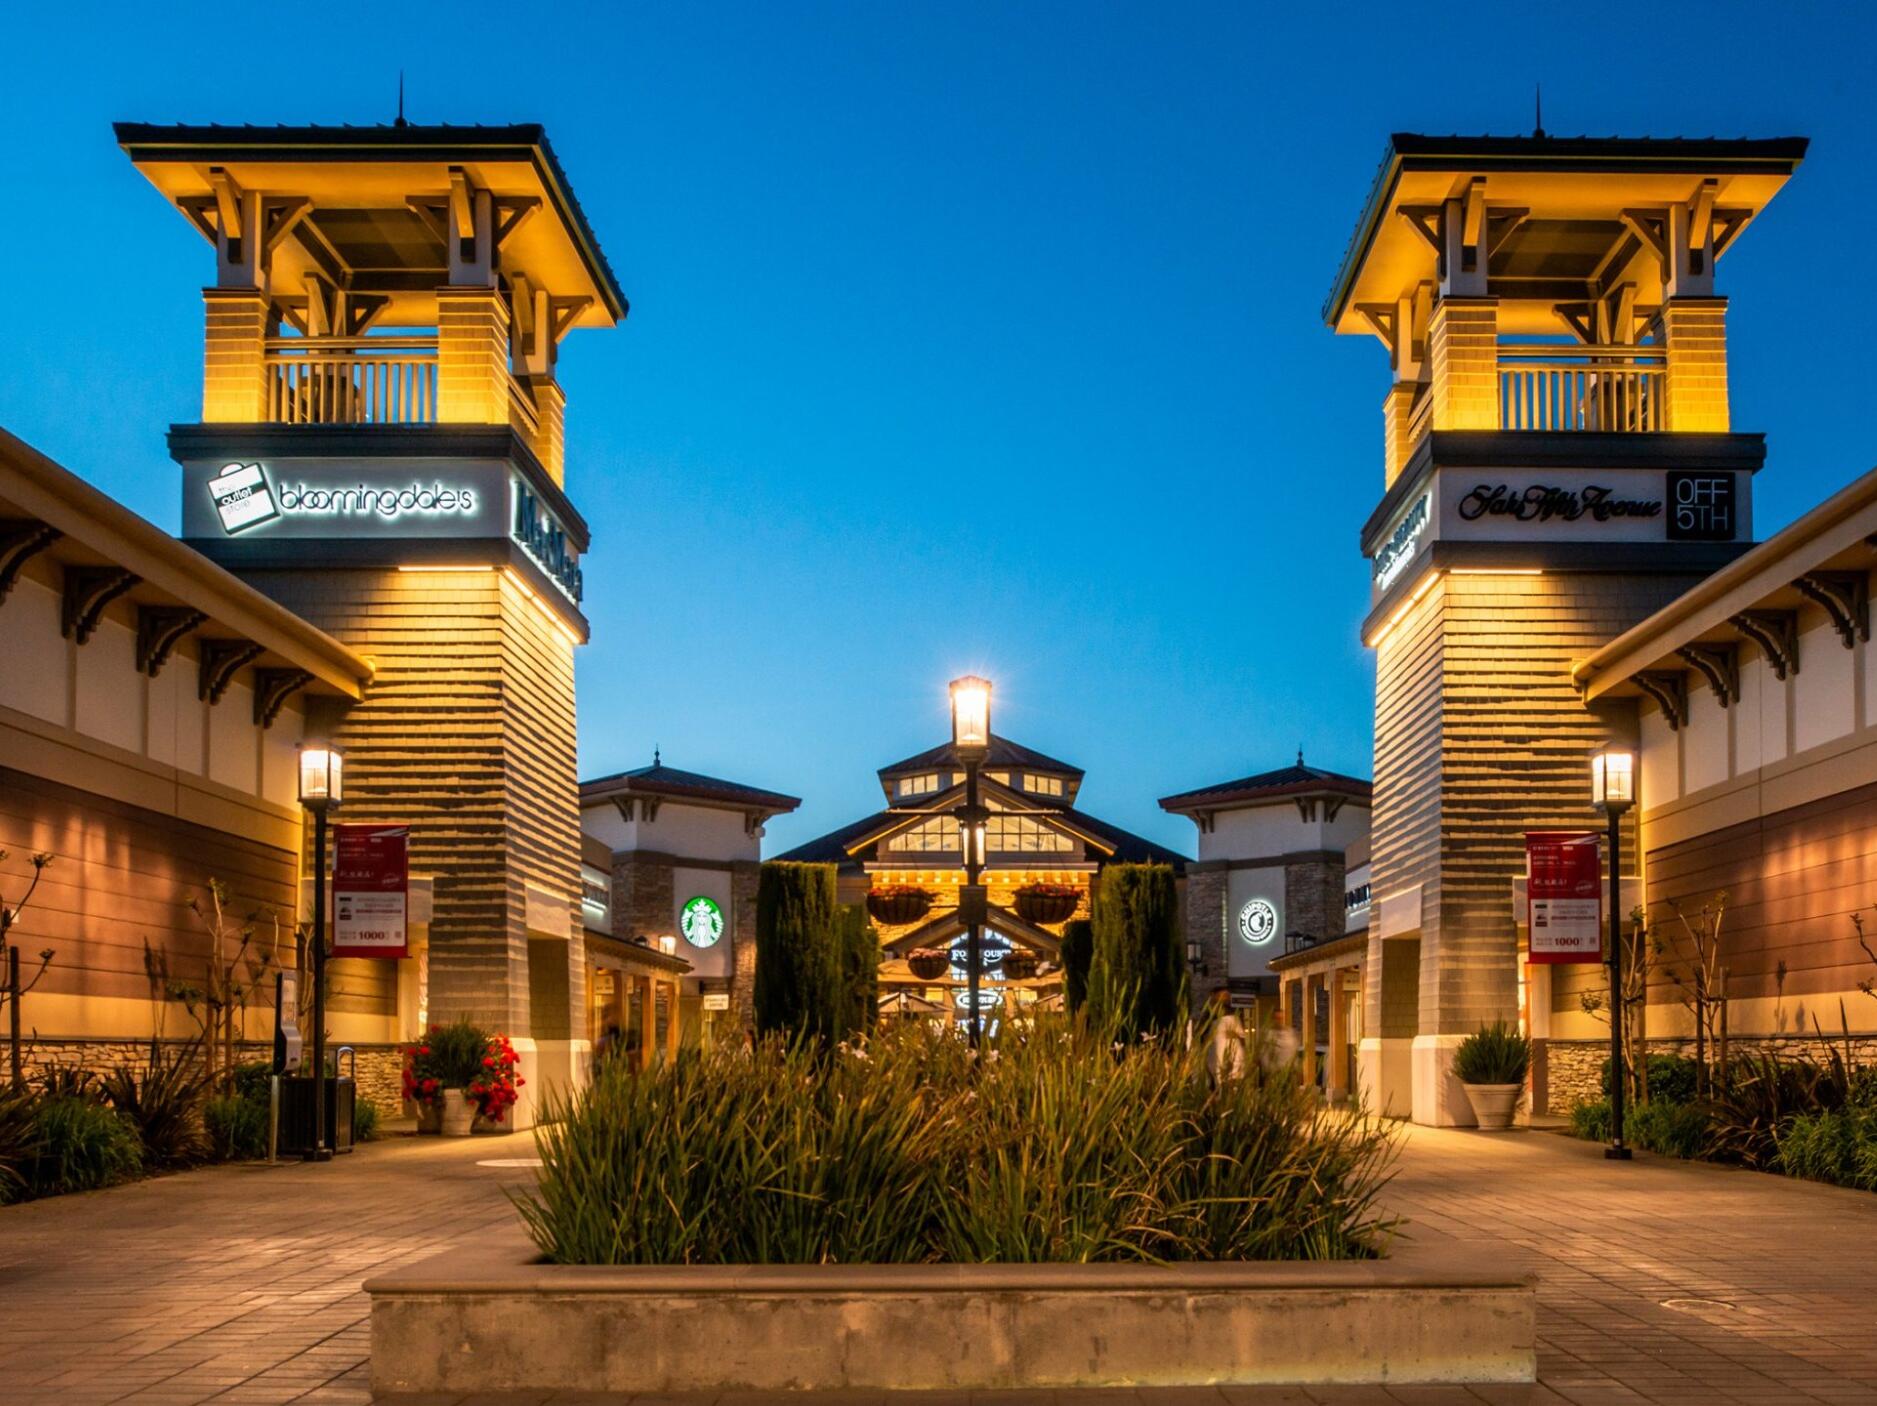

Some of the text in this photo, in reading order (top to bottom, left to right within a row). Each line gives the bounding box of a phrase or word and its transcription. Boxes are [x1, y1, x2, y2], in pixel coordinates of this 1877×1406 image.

[221, 486, 253, 506] outlet
[279, 484, 473, 515] bloomingdale's
[1459, 484, 1662, 522] Saks Fifth Avenue
[1676, 478, 1729, 505] OFF
[1677, 504, 1728, 530] 5TH
[358, 931, 385, 940] 1000
